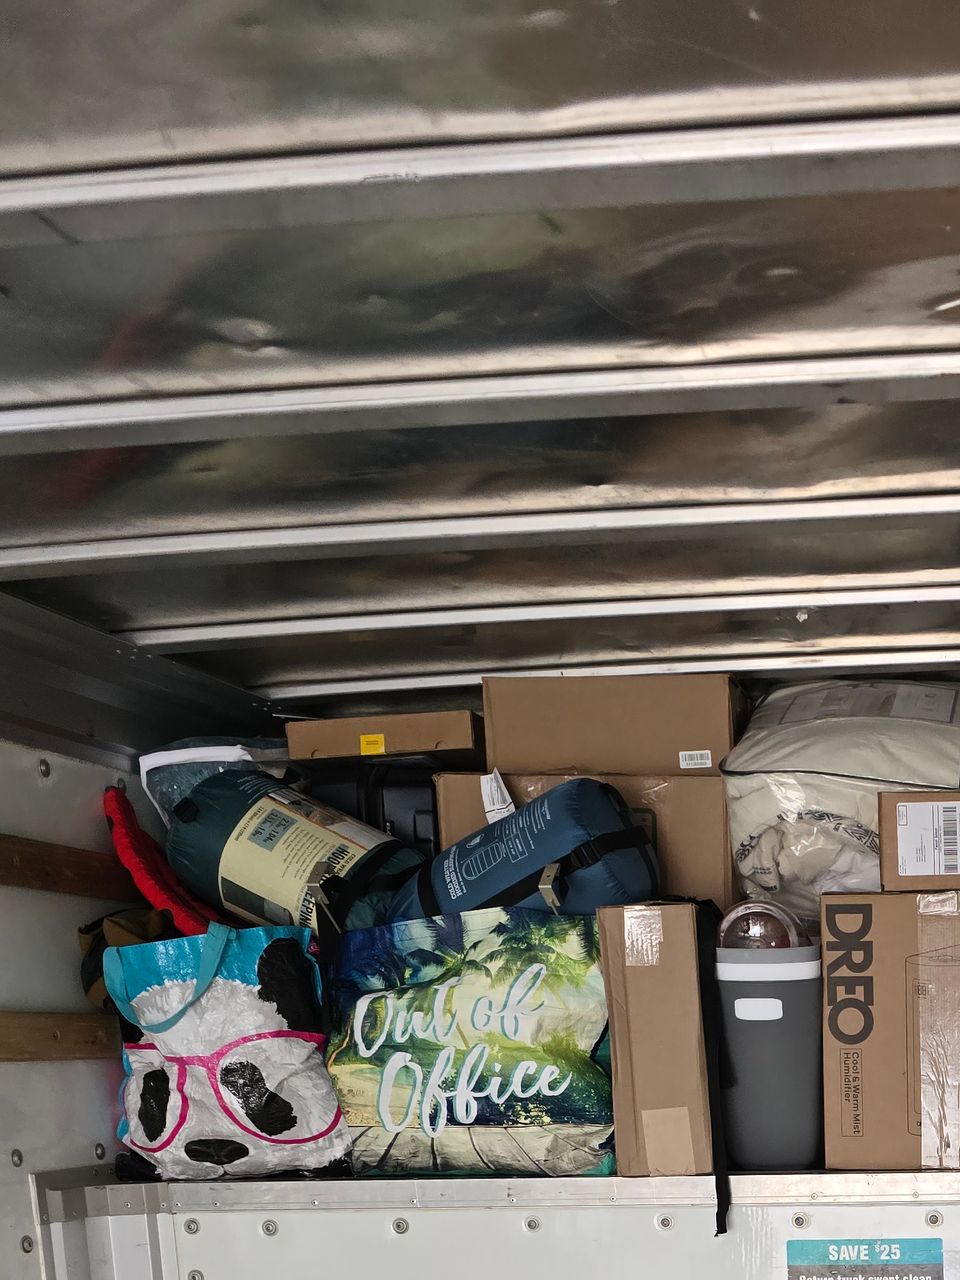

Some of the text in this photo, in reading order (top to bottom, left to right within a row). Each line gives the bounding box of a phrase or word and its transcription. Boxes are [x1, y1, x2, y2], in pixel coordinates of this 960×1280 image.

[825, 903, 874, 1045] DREO
[354, 963, 547, 1058] Out of
[842, 1052, 851, 1103] Humidifier
[851, 1051, 859, 1073] Cool
[378, 1043, 572, 1138] Office
[852, 1084, 860, 1111] Warm
[852, 1113, 861, 1134] Mist
[828, 1241, 900, 1261] SAVE $25
